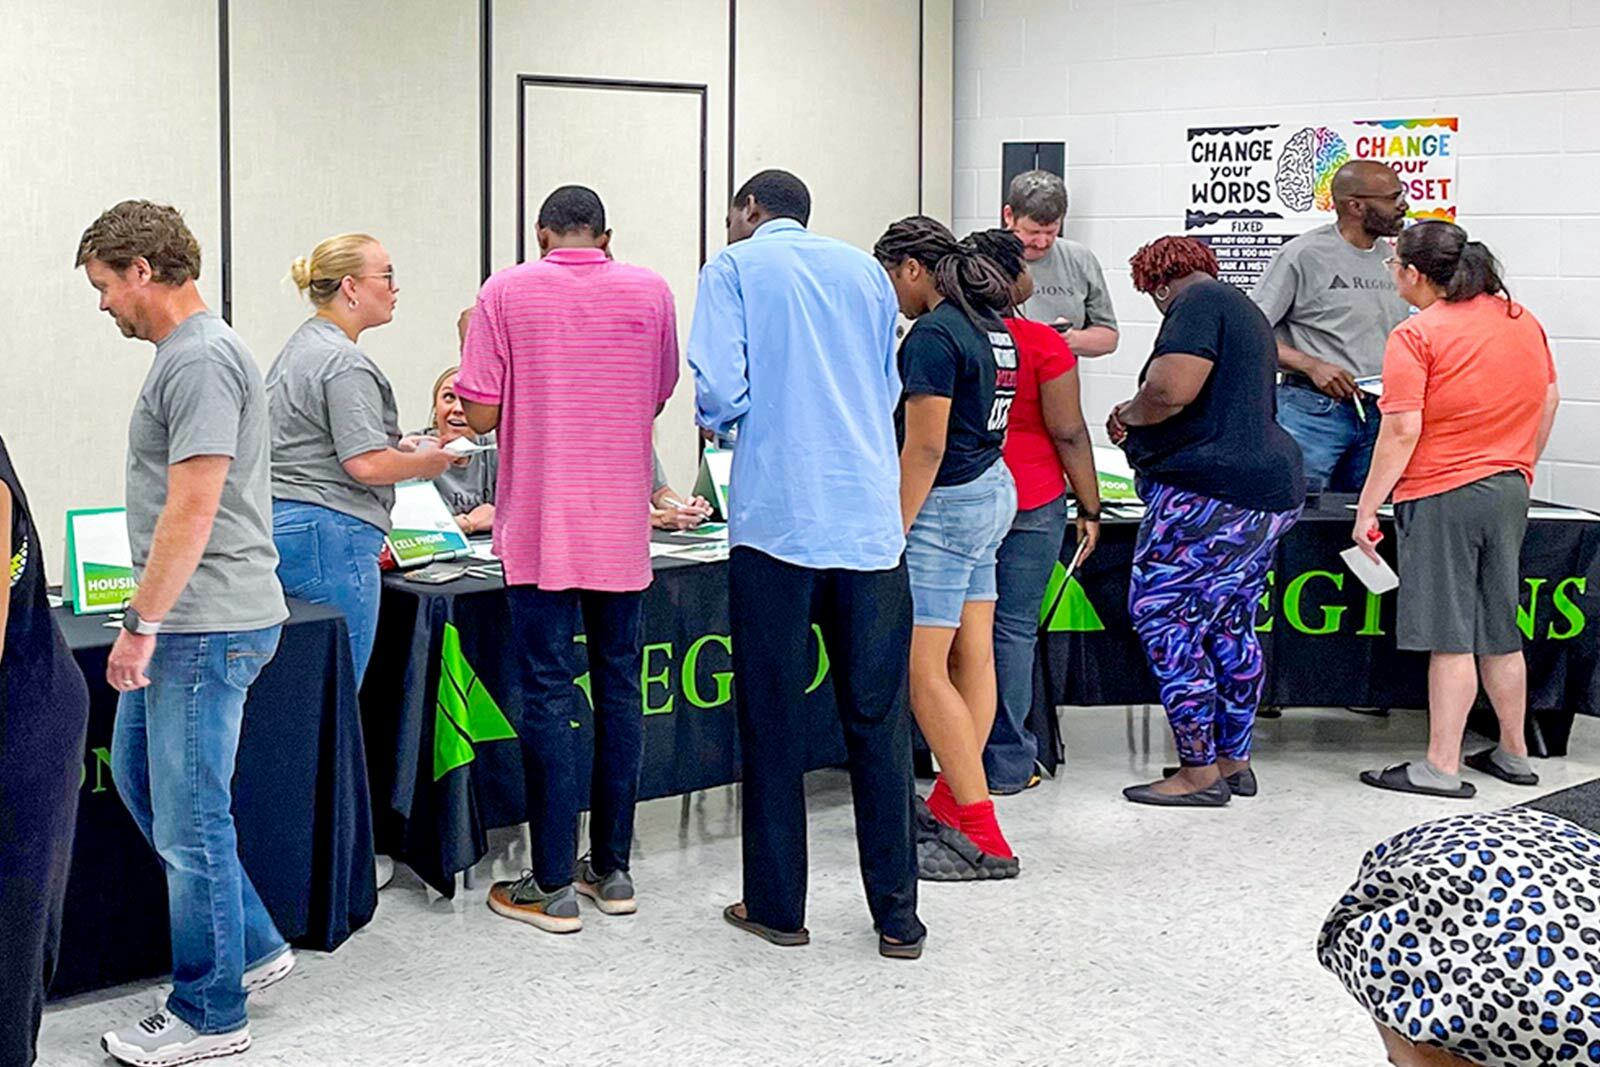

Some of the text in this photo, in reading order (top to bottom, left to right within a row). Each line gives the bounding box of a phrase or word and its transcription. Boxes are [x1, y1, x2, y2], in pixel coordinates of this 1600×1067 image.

[1191, 140, 1273, 163] CHANGE
[1356, 134, 1451, 159] CHANGE
[1209, 165, 1253, 181] your
[1385, 160, 1430, 175] our
[1191, 180, 1272, 204] WORDS
[1231, 221, 1264, 233] FIXED
[1241, 248, 1258, 257] TOO
[394, 532, 447, 550] CELL PHONE
